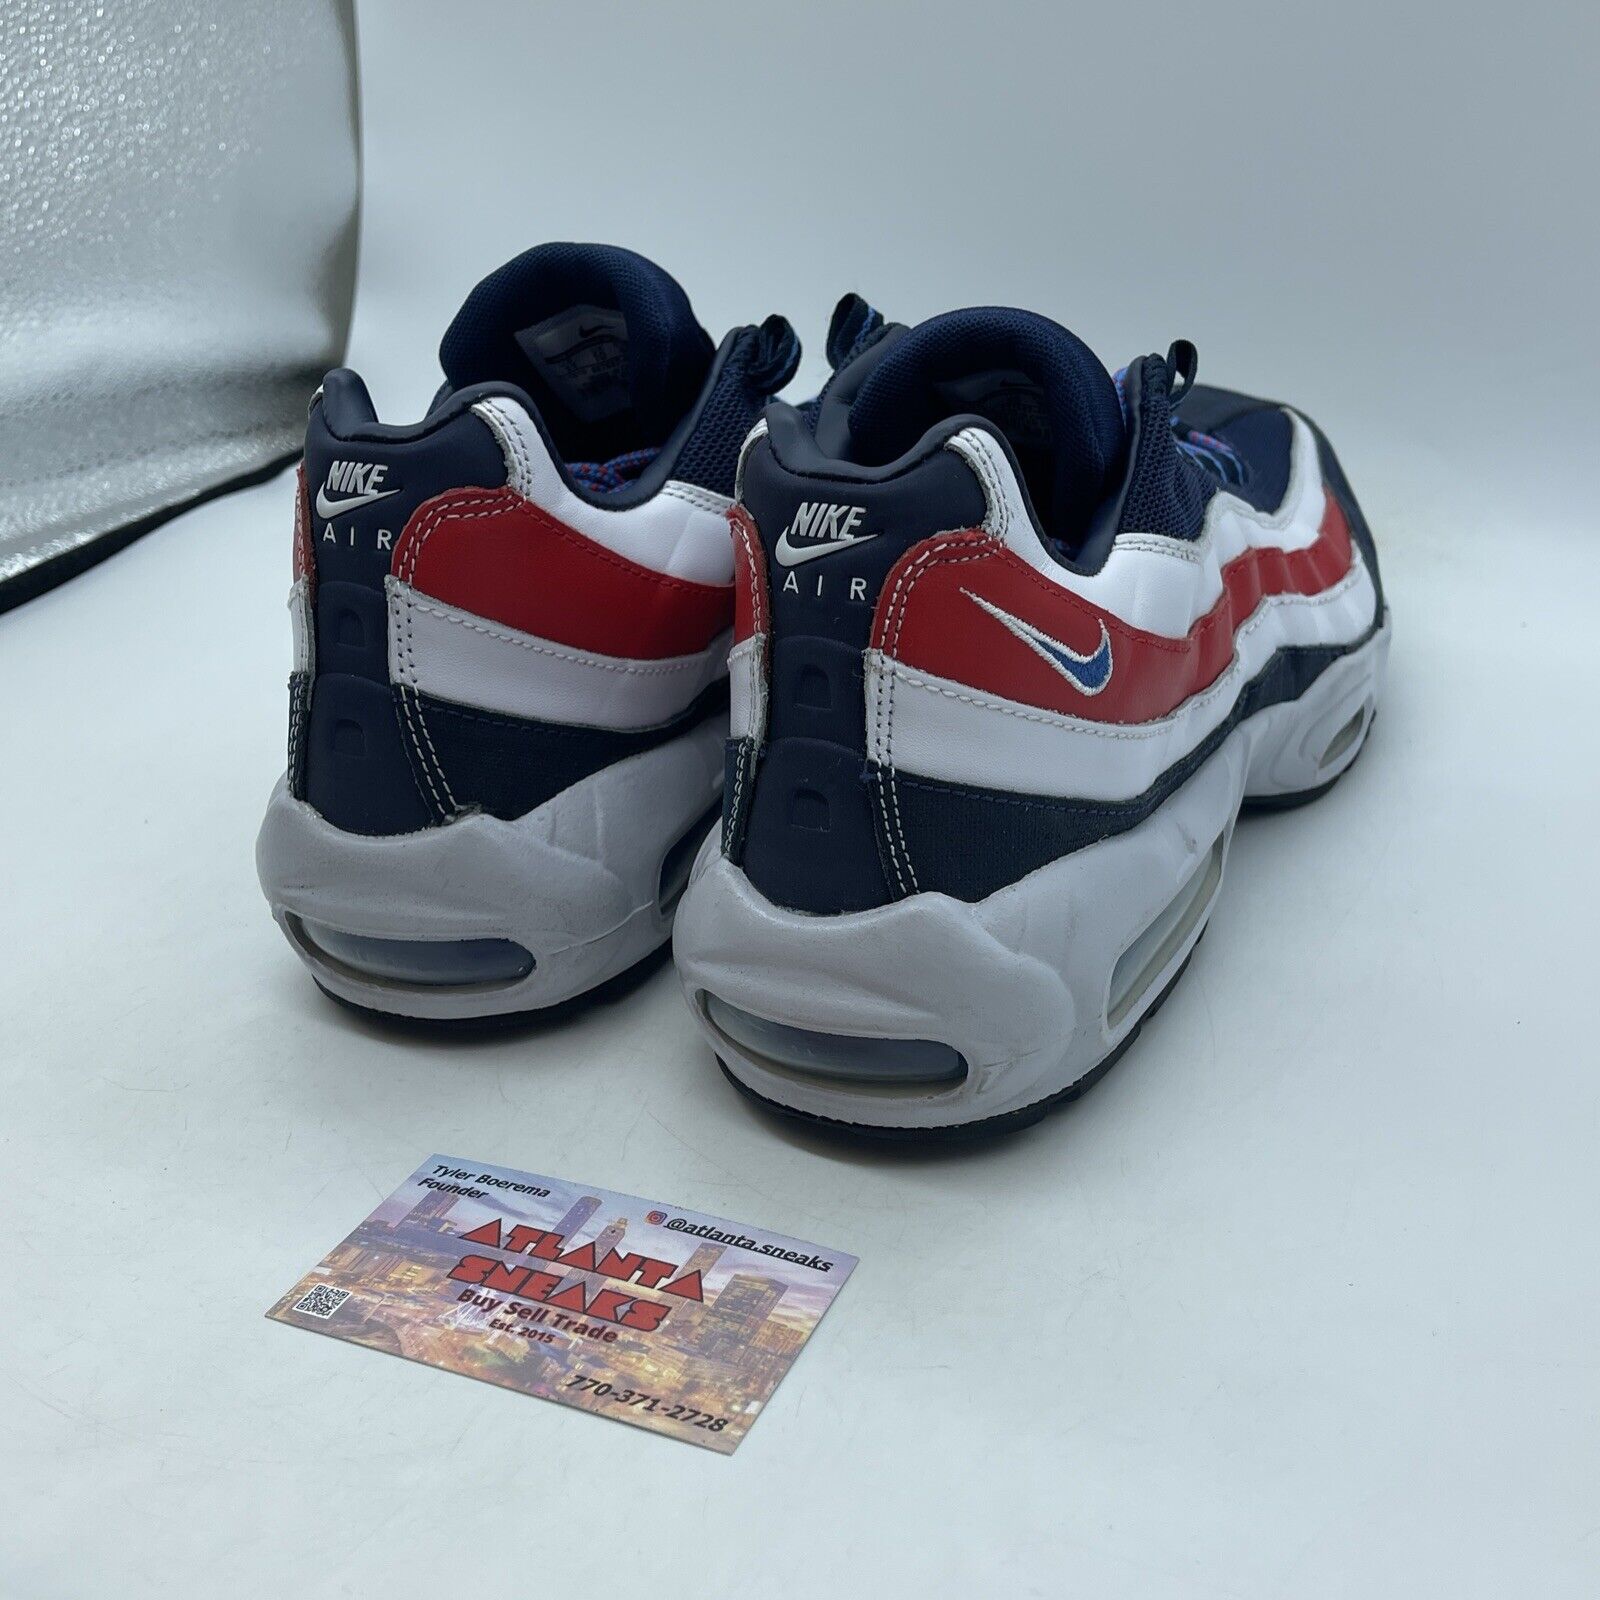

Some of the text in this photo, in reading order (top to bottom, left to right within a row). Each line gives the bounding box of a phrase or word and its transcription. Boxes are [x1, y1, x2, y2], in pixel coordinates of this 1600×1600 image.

[326, 460, 388, 494] NIKE
[322, 522, 392, 550] AIR
[790, 502, 866, 540] NIKE
[782, 570, 867, 600] AIR
[417, 1177, 489, 1199] Founder
[432, 1165, 551, 1198] Tyler Boerema
[458, 1217, 704, 1303] ATLANTA
[664, 1218, 834, 1272] @atlanta.sneaks
[447, 1254, 672, 1332] SNEAKS
[456, 1288, 619, 1344] Buy Sell Trade
[488, 1318, 556, 1344] Est. 2015
[566, 1374, 729, 1432] 770-371-2728
